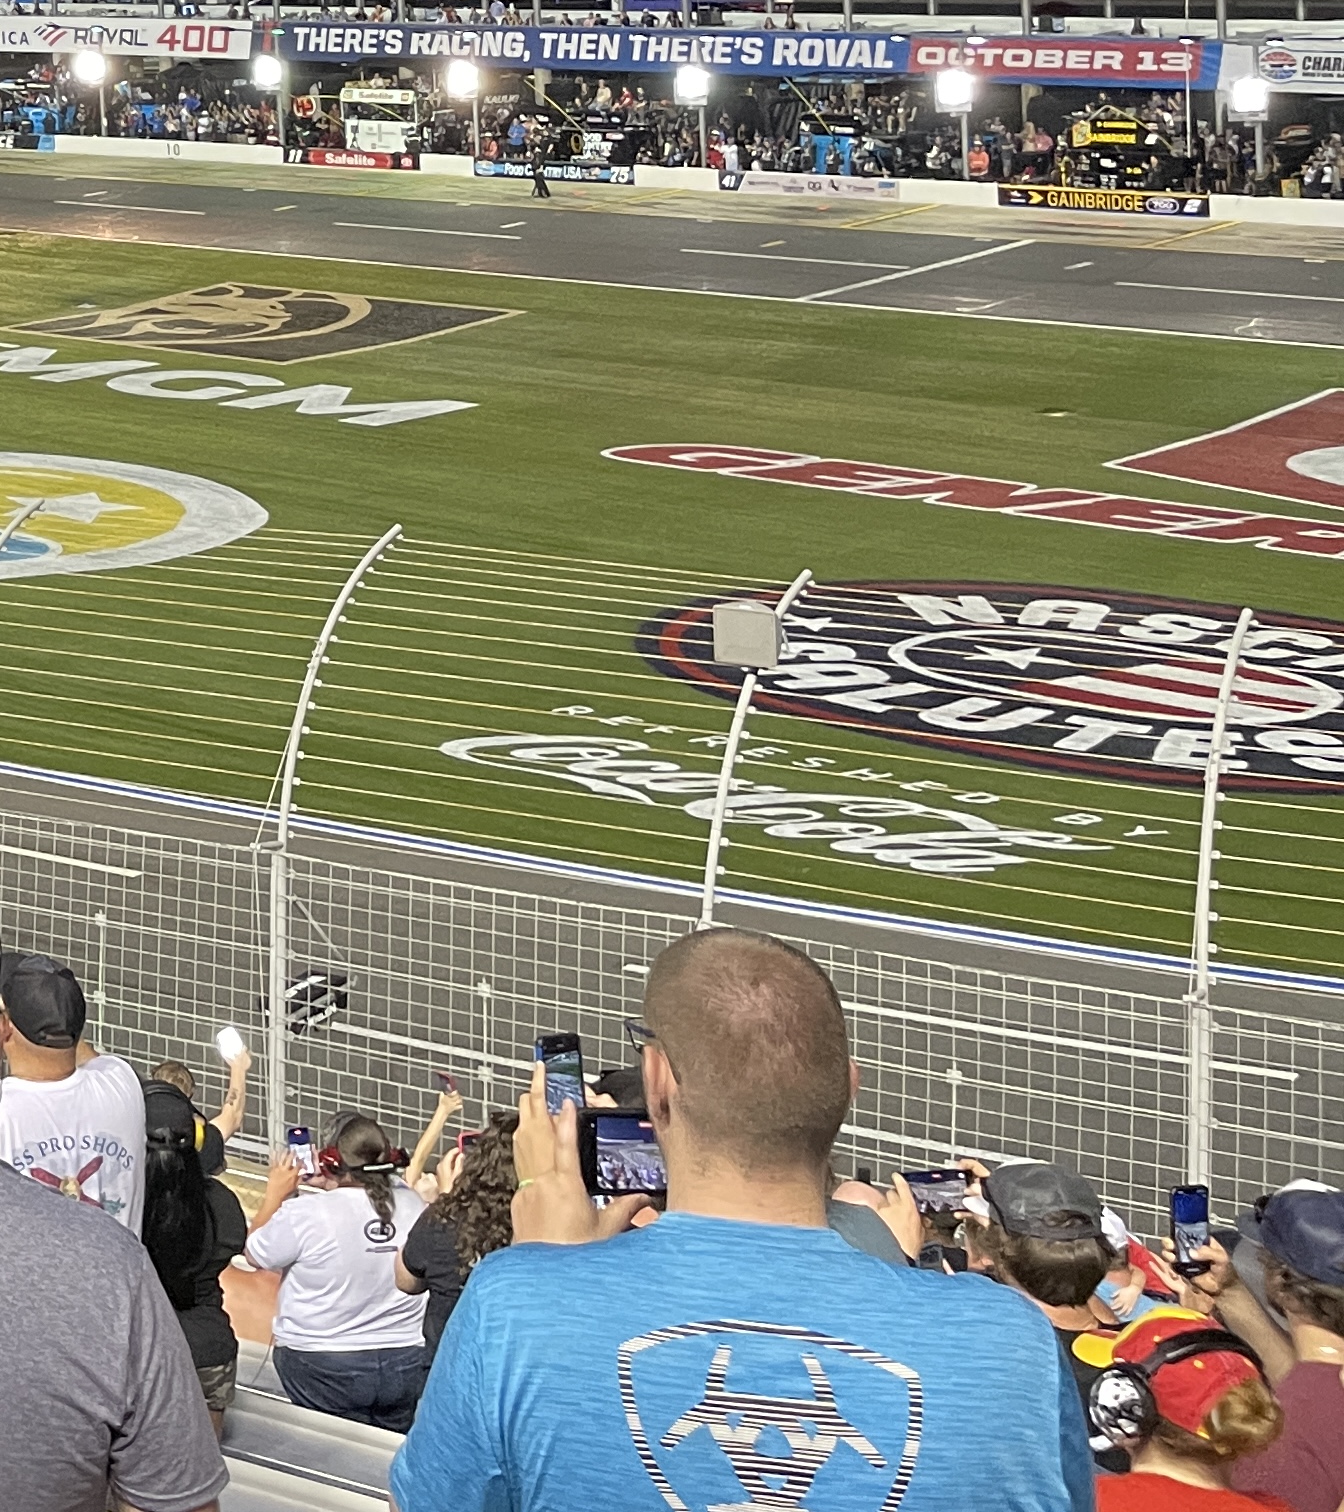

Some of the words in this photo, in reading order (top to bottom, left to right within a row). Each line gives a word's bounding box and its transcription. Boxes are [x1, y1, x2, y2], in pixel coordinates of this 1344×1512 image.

[157, 24, 229, 54] 400
[292, 26, 402, 55] THERE'S
[410, 32, 531, 62] RACING,
[540, 32, 619, 61] THEN
[629, 35, 762, 66] THERE'S
[772, 37, 893, 69] ROVAL
[916, 45, 1124, 71] OCTOBER
[1136, 50, 1192, 72] 13
[1302, 55, 1344, 72] CHAR
[167, 143, 180, 156] 10
[324, 151, 376, 167] Safelite
[563, 165, 582, 179] USA
[610, 166, 631, 184] 75
[721, 174, 737, 188] 41
[1047, 191, 1144, 213] GAINBRIDGE
[552, 703, 1001, 805] REFRESHED
[1054, 813, 1169, 839] BY
[438, 733, 1115, 873] Coca-Cola
[13, 1149, 34, 1172] SS
[38, 1134, 75, 1158] PRO
[80, 1134, 134, 1170] SHOPS
